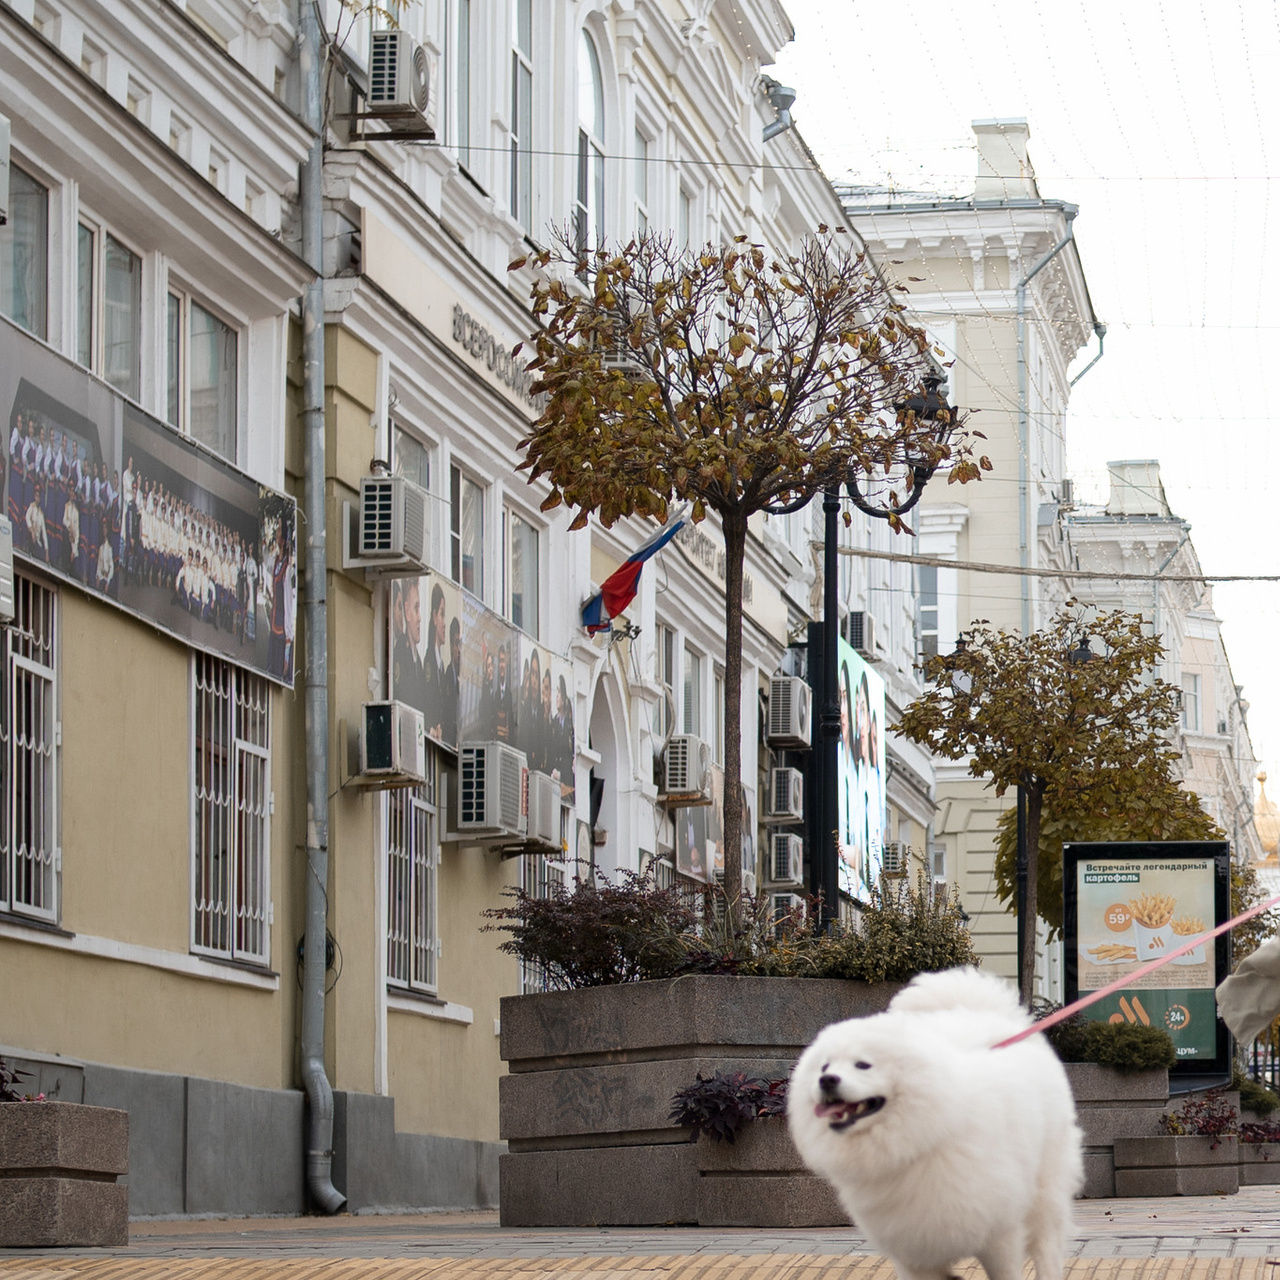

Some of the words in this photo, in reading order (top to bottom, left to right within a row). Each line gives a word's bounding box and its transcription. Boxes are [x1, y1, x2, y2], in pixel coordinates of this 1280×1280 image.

[1086, 863, 1140, 872] Встречайте
[1142, 862, 1207, 872] легендарный
[1086, 873, 1138, 883] картофель
